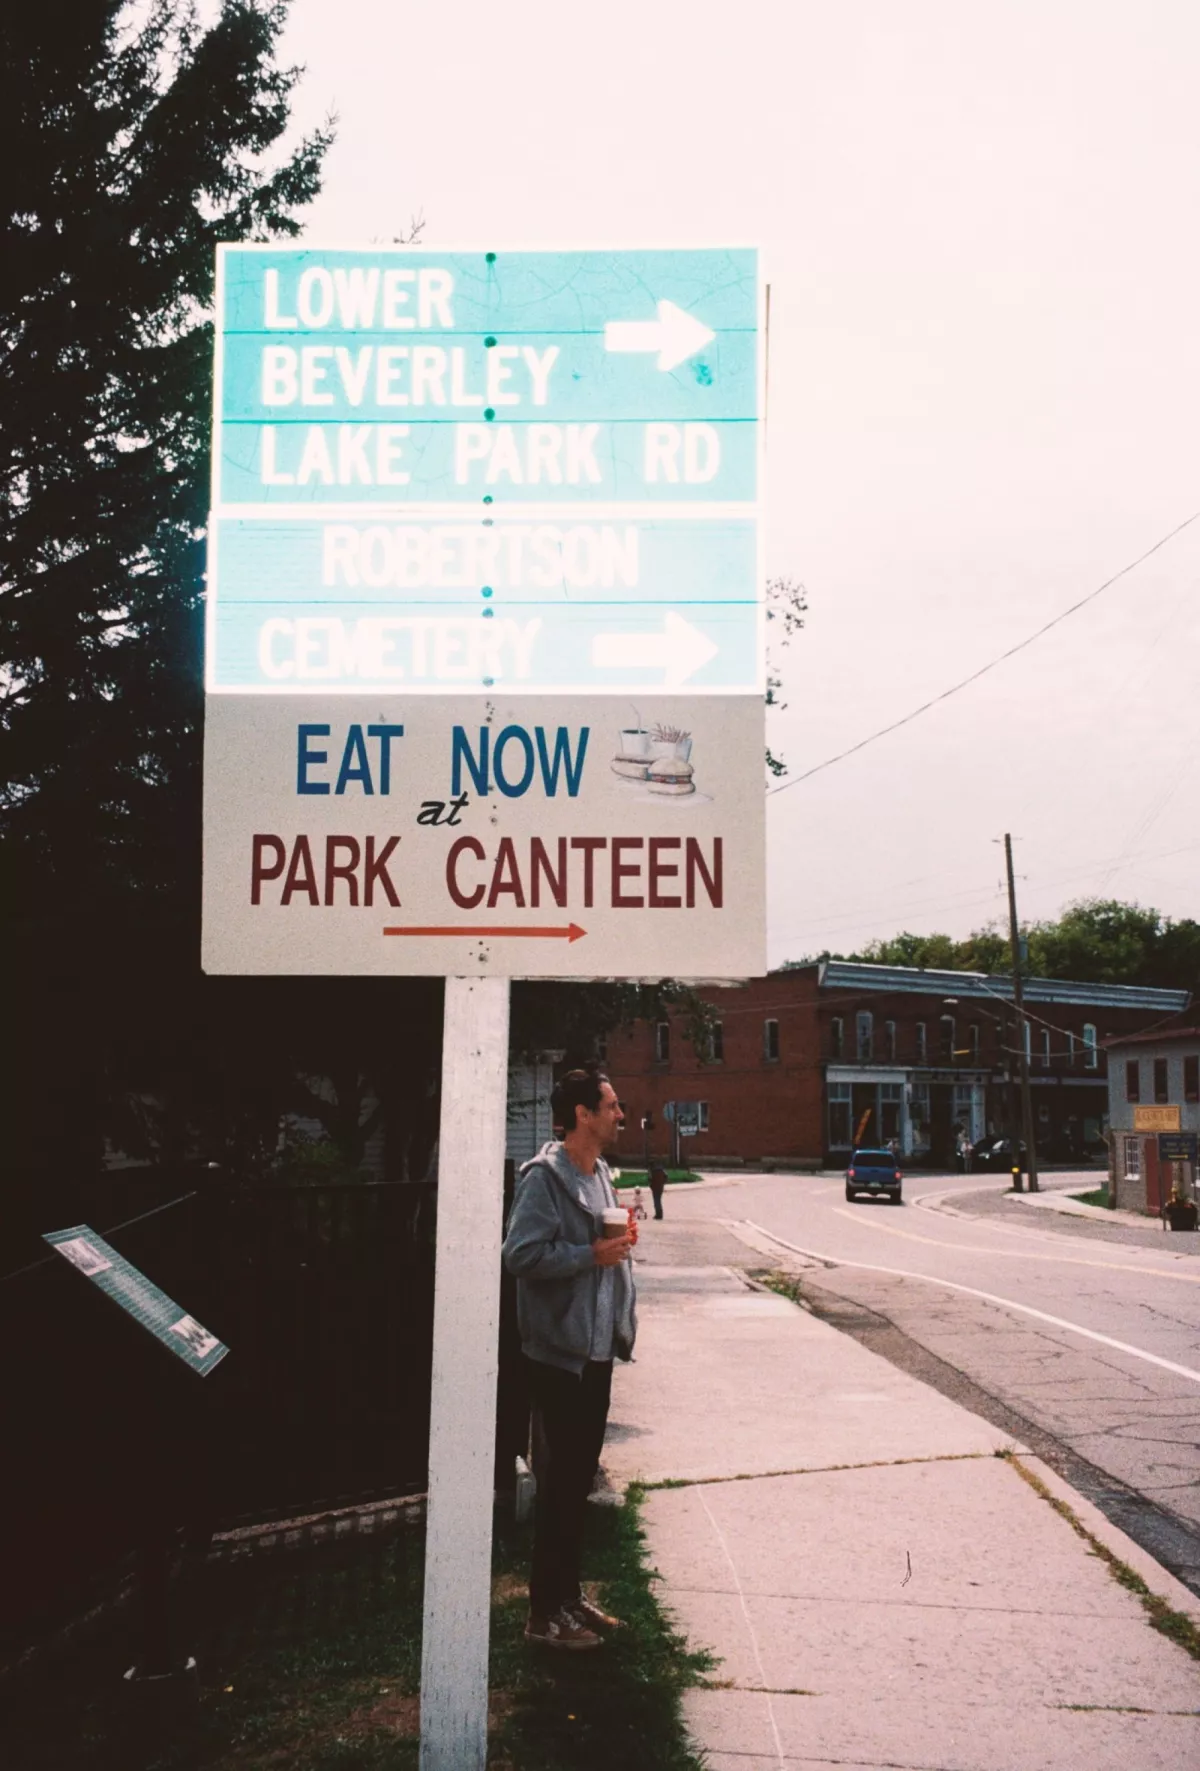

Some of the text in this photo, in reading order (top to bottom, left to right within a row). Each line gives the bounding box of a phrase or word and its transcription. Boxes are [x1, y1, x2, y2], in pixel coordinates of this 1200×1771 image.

[264, 267, 455, 329] LOWER
[260, 345, 560, 407] BEVERLEY
[260, 422, 721, 486] LAKE PARK RD
[322, 525, 640, 588] ROBERTSON
[258, 616, 543, 680] CEMETERY
[297, 724, 590, 798] EAT NOW
[416, 791, 469, 826] at
[251, 834, 723, 910] PARK CANTEEN
